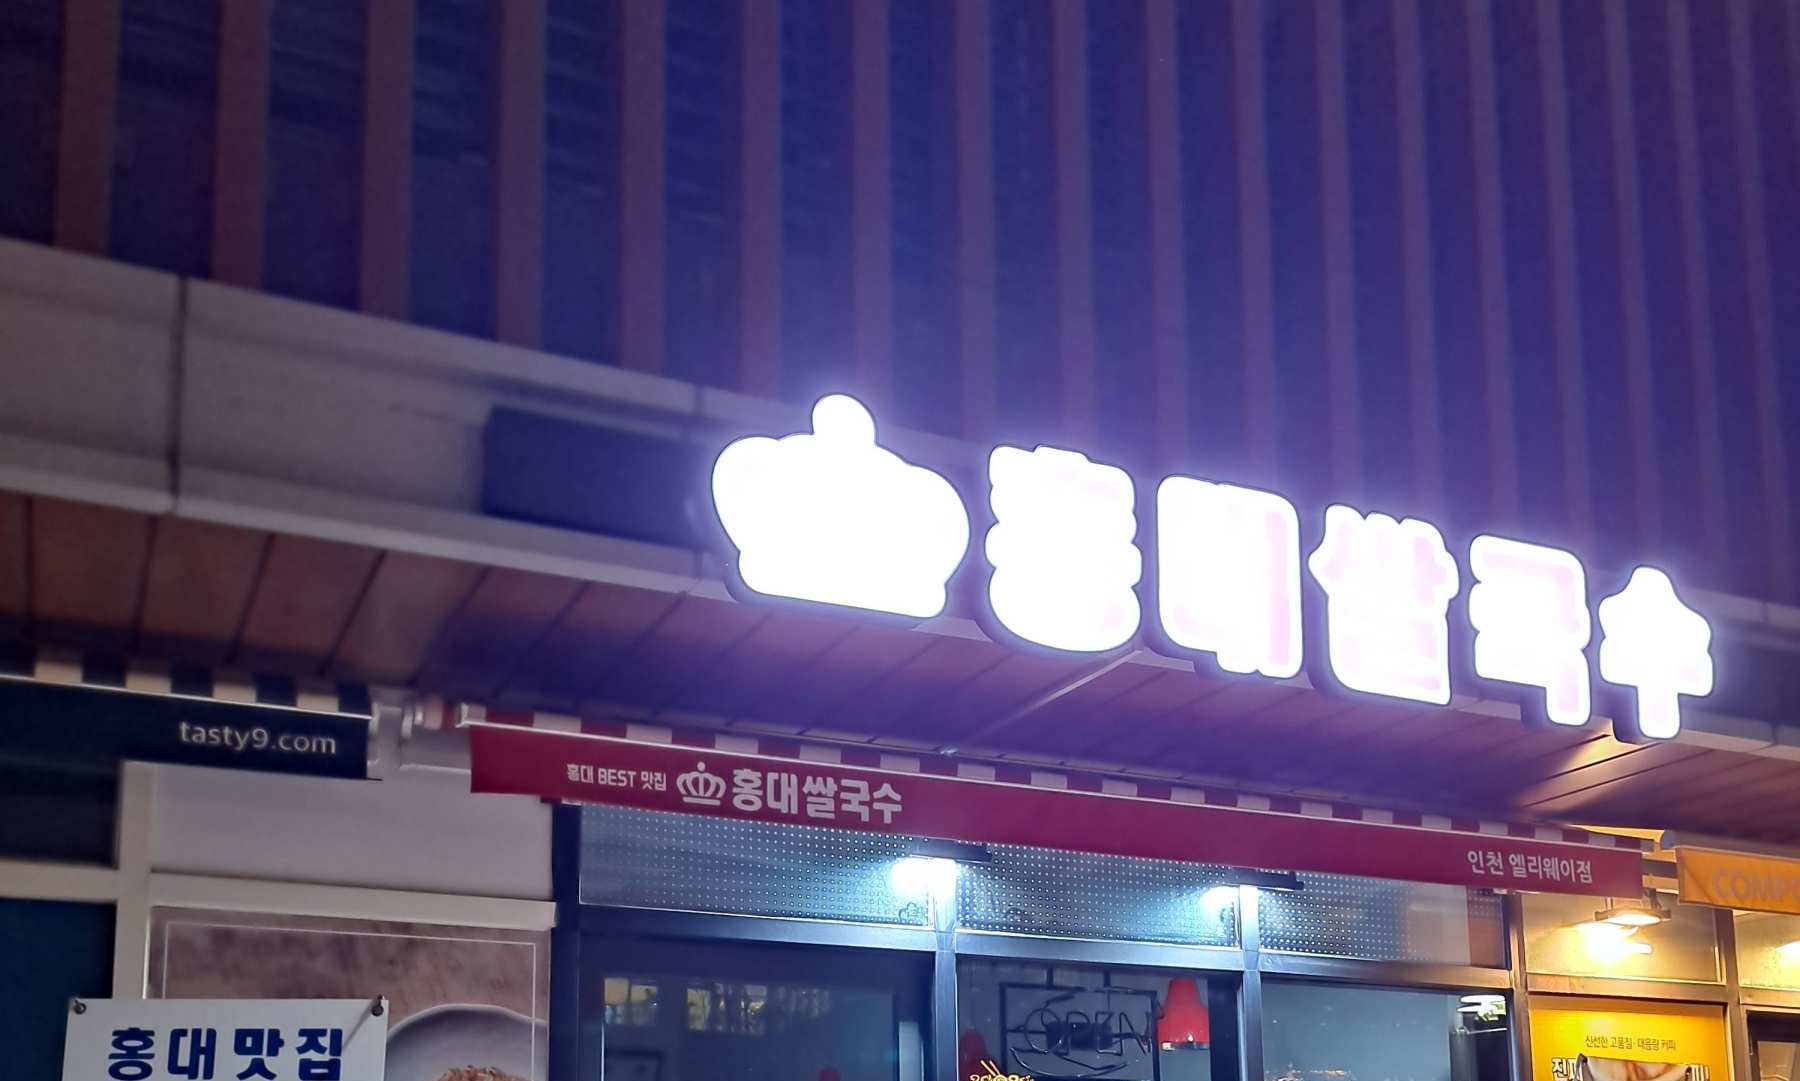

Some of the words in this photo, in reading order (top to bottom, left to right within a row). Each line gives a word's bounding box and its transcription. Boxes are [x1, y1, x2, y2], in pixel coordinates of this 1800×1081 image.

[179, 721, 337, 755] tasty9.com
[566, 763, 594, 785] 홍대
[597, 767, 637, 789] BEST
[641, 770, 667, 792] 맛집
[732, 768, 903, 824] 홍대쌀국수
[1467, 849, 1504, 877] 인천
[108, 1027, 218, 1081] 홍대
[232, 1028, 343, 1081] 맛집
